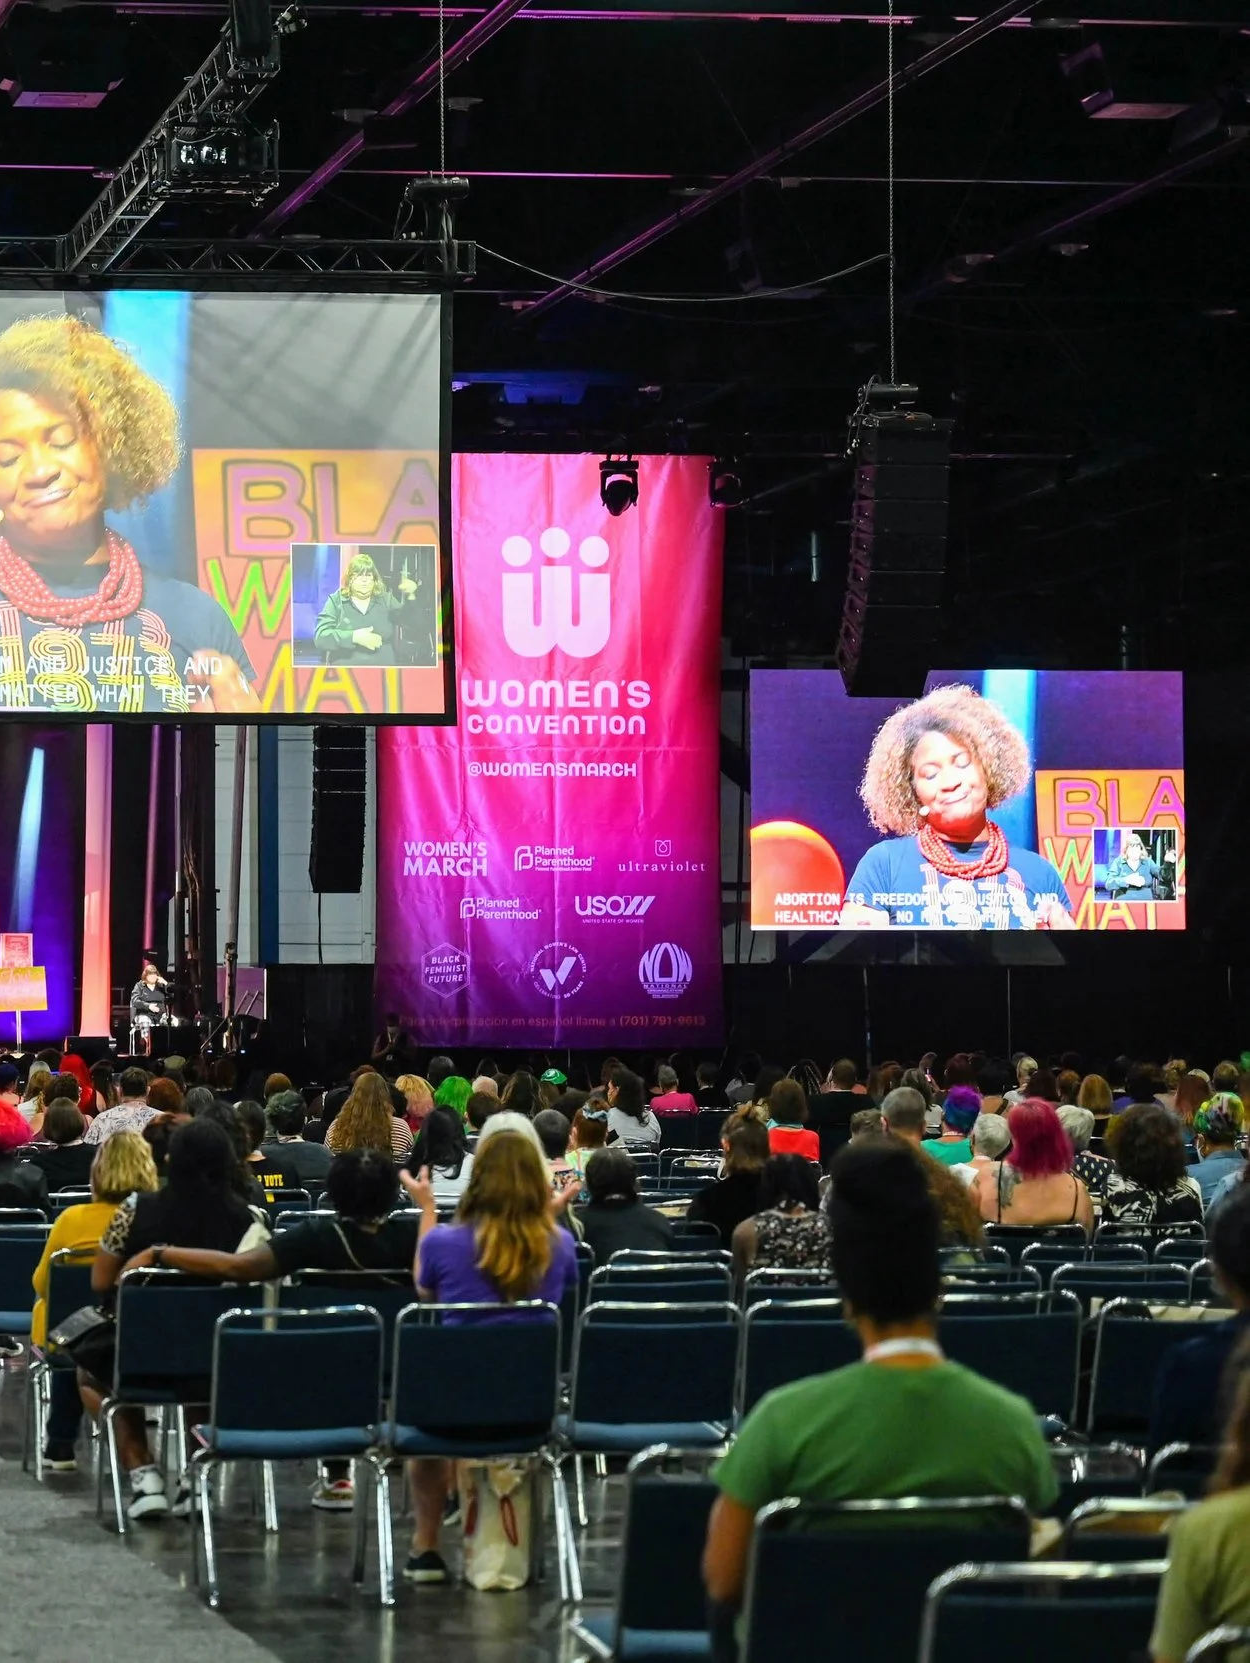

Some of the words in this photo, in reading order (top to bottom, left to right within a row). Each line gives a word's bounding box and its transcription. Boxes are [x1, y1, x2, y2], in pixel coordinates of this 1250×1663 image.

[26, 655, 67, 675] AND
[81, 655, 170, 675] JUSTICE
[183, 655, 223, 675] AND
[0, 684, 79, 703] MATTER
[92, 684, 145, 703] WHAT
[161, 684, 211, 703] THEY
[461, 679, 651, 708] WOMEN'S
[467, 714, 646, 735] CONVENTION
[403, 841, 488, 857] WOMEN'S
[535, 845, 575, 855] Planned
[403, 857, 488, 877] MARCH
[618, 861, 706, 872] ultraviolet
[476, 898, 520, 908] Planned
[774, 892, 841, 906] ABORTION
[850, 892, 865, 906] IS
[896, 910, 913, 923] NO
[431, 955, 460, 965] BLACK
[638, 942, 693, 983] NOW
[425, 964, 467, 974] FEMINIST
[428, 974, 463, 984] FUTURE
[619, 1015, 649, 1028] (701)
[263, 1173, 284, 1187] VOTE
